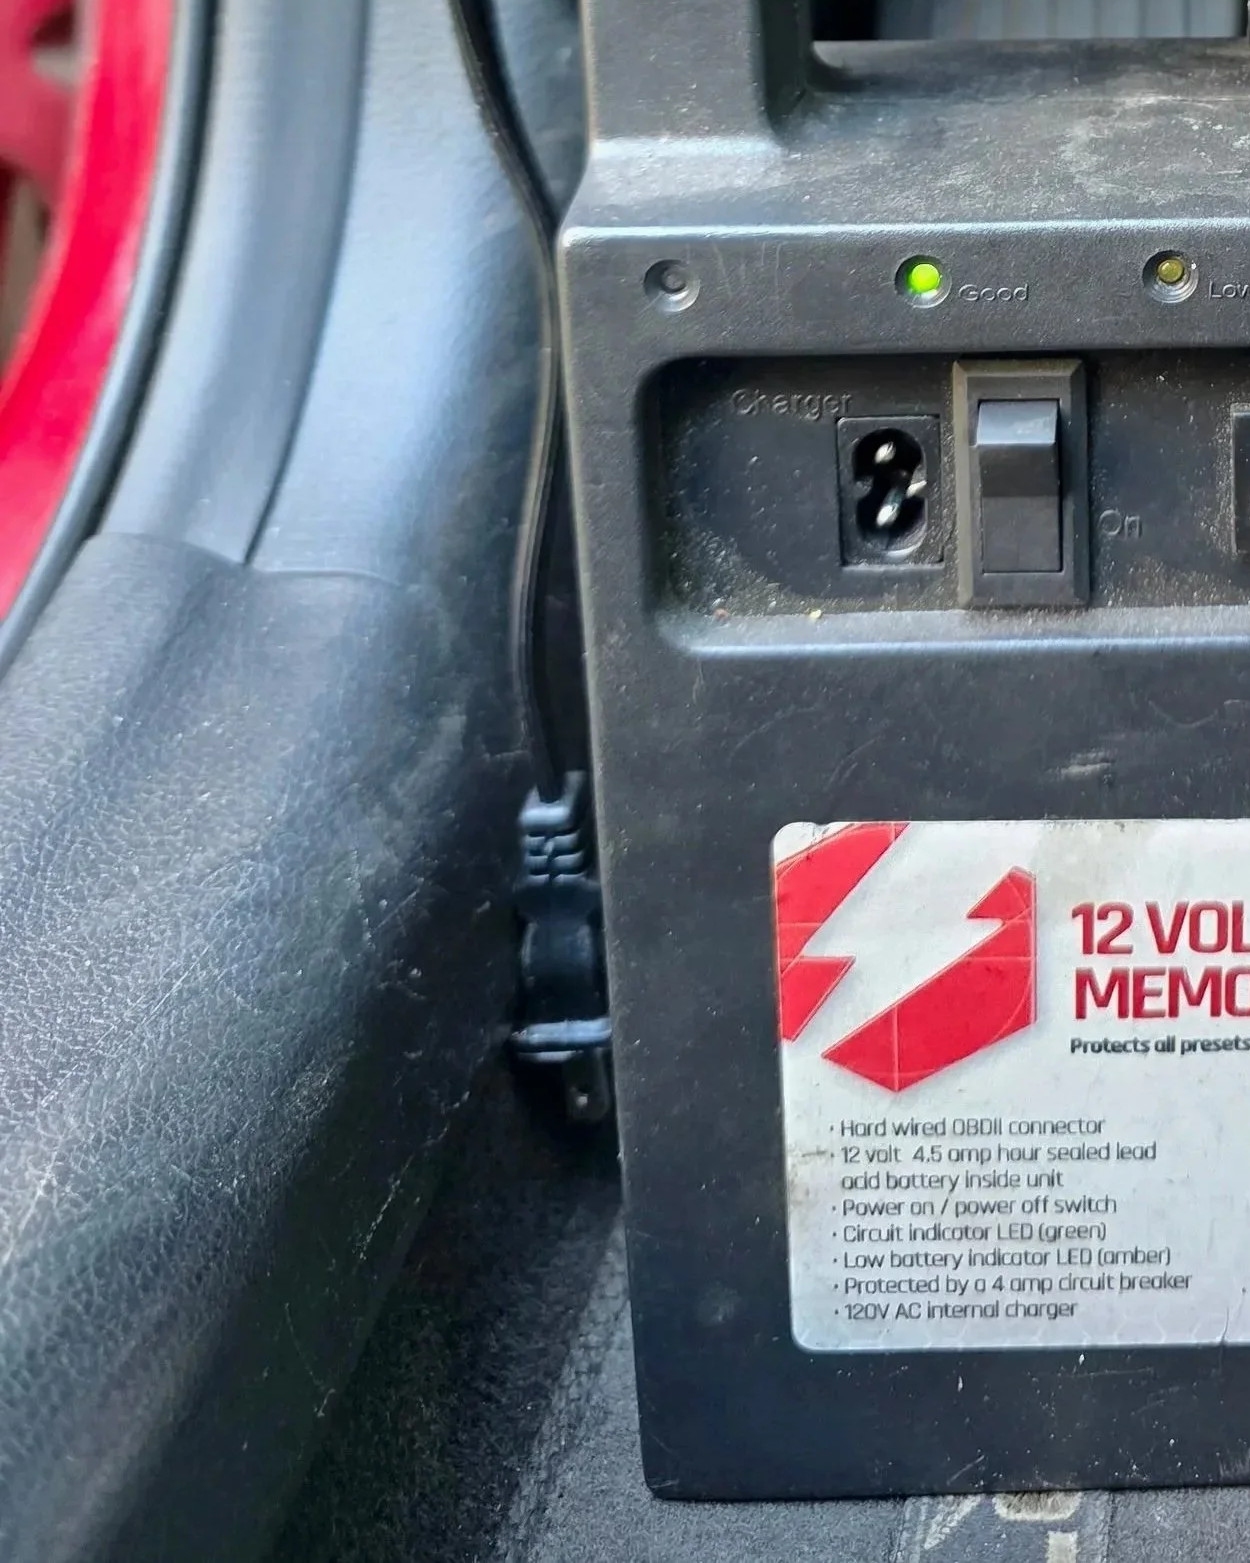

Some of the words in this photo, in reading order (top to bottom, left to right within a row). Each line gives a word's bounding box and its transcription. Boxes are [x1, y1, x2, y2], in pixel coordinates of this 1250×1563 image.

[958, 283, 1029, 302] Good
[731, 388, 853, 421] Charger
[1097, 508, 1143, 539] On
[1071, 902, 1134, 956] 12
[1070, 1037, 1151, 1056] Protects
[1154, 1035, 1175, 1054] all
[841, 1118, 887, 1138] Hard
[891, 1117, 946, 1138] wired
[1009, 1118, 1106, 1136] connector
[841, 1145, 860, 1164] 12
[864, 1144, 902, 1165] volt
[912, 1145, 942, 1164] 4.5
[948, 1148, 992, 1167] amp
[996, 1143, 1042, 1163] hour
[1047, 1142, 1110, 1163] sealed
[1116, 1141, 1156, 1161] lead
[842, 1171, 880, 1191] acid
[886, 1171, 960, 1195] battery
[965, 1169, 1021, 1191] inside
[1027, 1169, 1064, 1190] unit
[843, 1199, 905, 1219] Power
[910, 1201, 934, 1217] on
[940, 1198, 949, 1215] /
[955, 1200, 1016, 1219] power
[1021, 1195, 1049, 1216] off
[1054, 1194, 1117, 1214] switch
[844, 1223, 903, 1244] Circuit
[909, 1222, 991, 1242] indicator
[997, 1223, 1033, 1242] LED
[1038, 1222, 1106, 1244] (green)
[844, 1252, 885, 1271] Low
[890, 1250, 963, 1271] battery
[968, 1246, 1051, 1269] indicator
[1057, 1247, 1092, 1268] LED
[1098, 1246, 1170, 1267] (amber)
[844, 1274, 940, 1296] Protected
[945, 1274, 969, 1297] by
[974, 1278, 986, 1294] a
[992, 1275, 1006, 1292] 4
[1010, 1277, 1053, 1295] amp
[1059, 1272, 1115, 1292] circuit
[1119, 1271, 1192, 1294] breaker
[845, 1303, 890, 1321] 120V
[895, 1302, 921, 1320] AC
[927, 1300, 999, 1321] internal
[1005, 1299, 1078, 1321] charger
